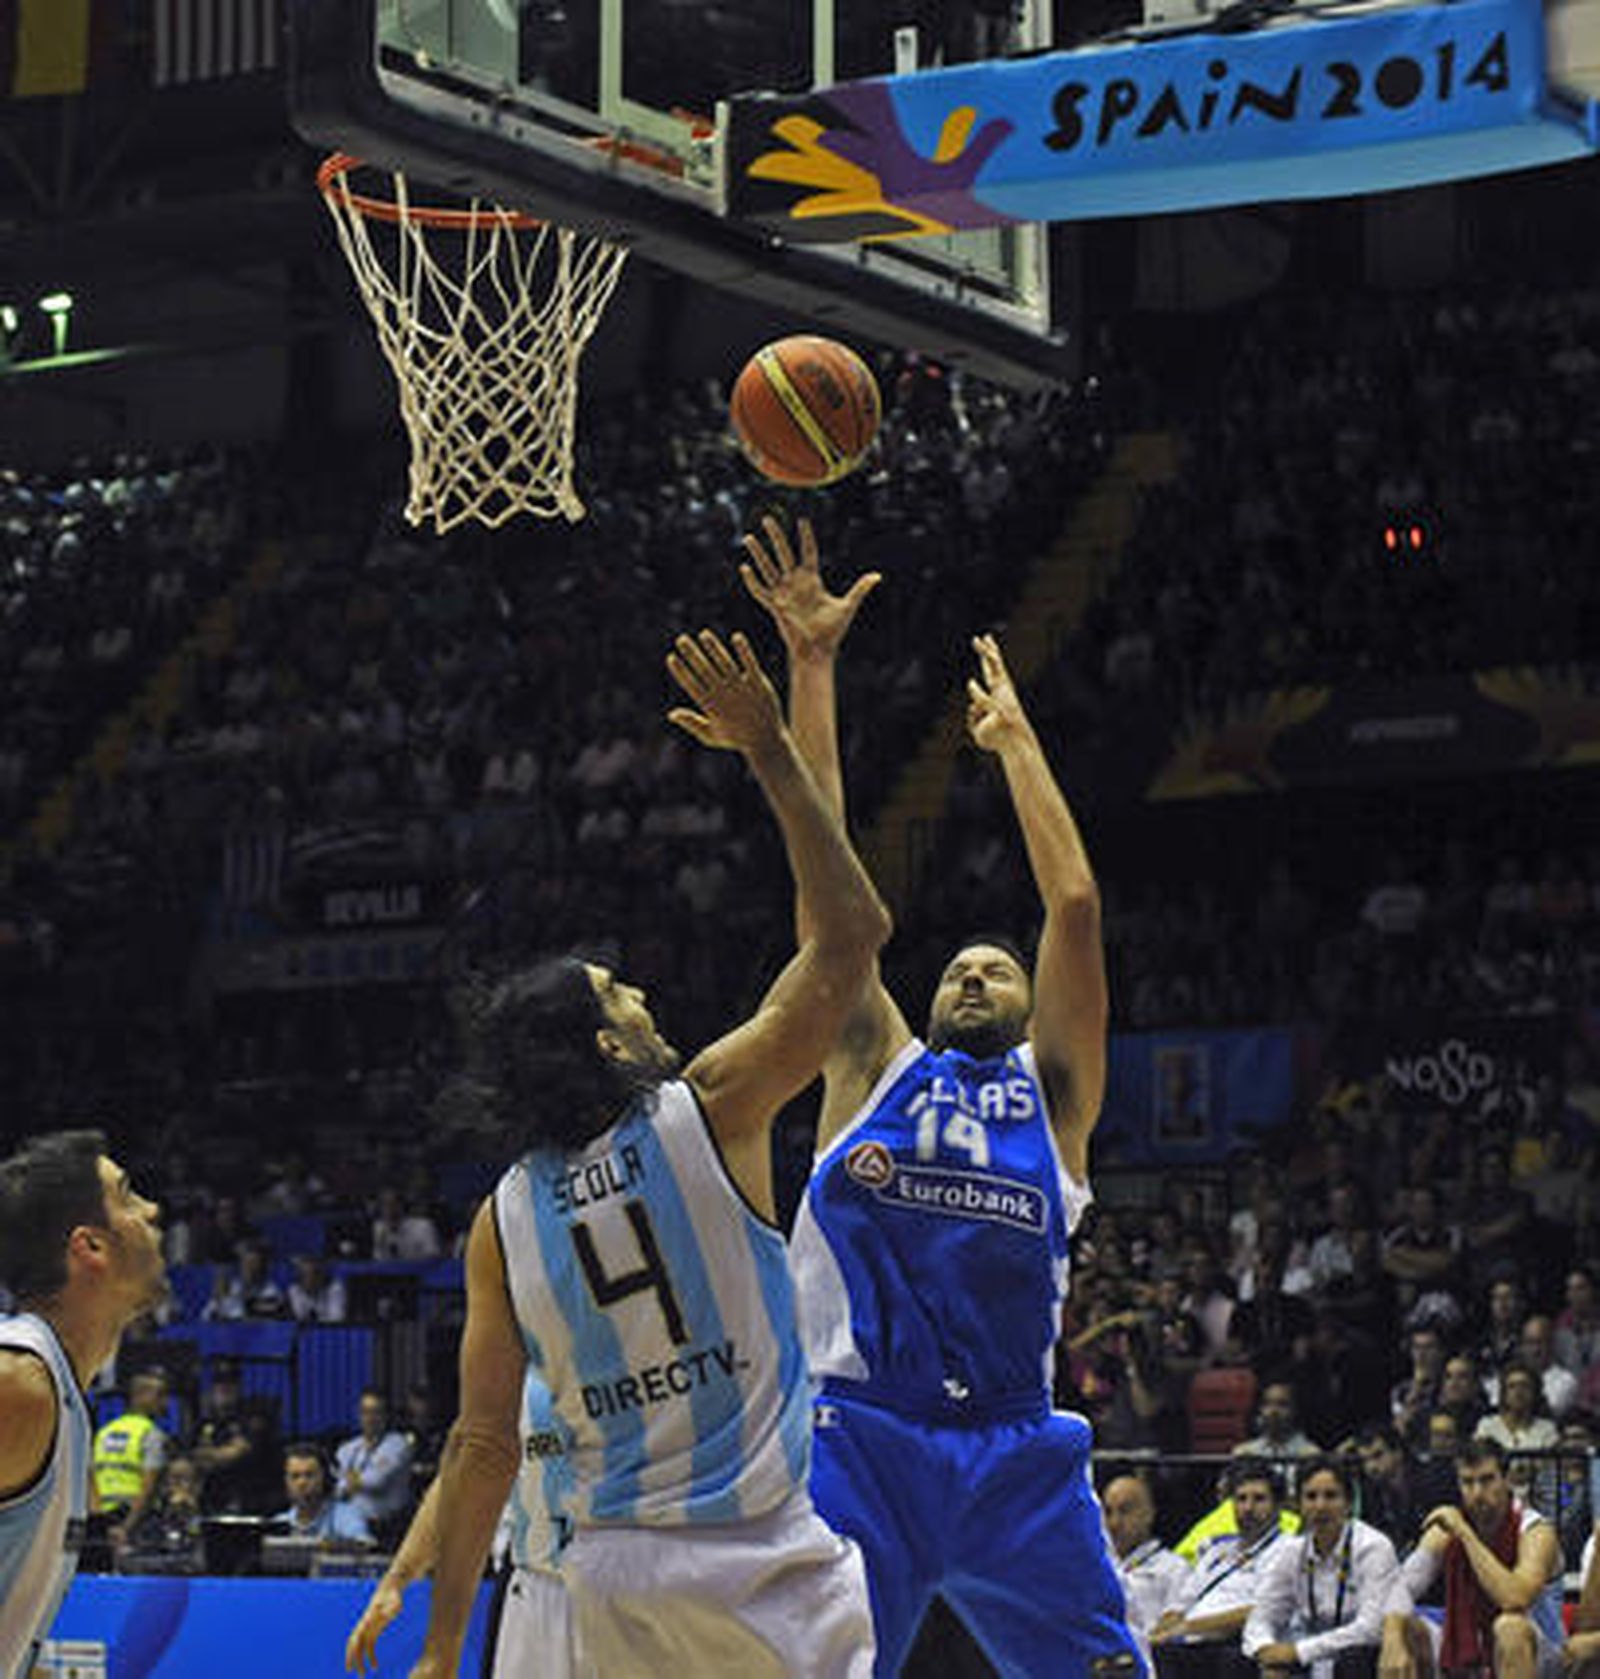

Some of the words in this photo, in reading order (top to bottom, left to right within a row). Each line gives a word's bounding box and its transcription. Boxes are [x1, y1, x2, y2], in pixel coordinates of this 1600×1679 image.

[1321, 31, 1510, 119] 2014
[553, 1145, 646, 1214] SCOLA
[899, 1174, 1037, 1221] Eurobank
[570, 1200, 689, 1346] 4
[582, 1341, 738, 1420] DIRECTV
